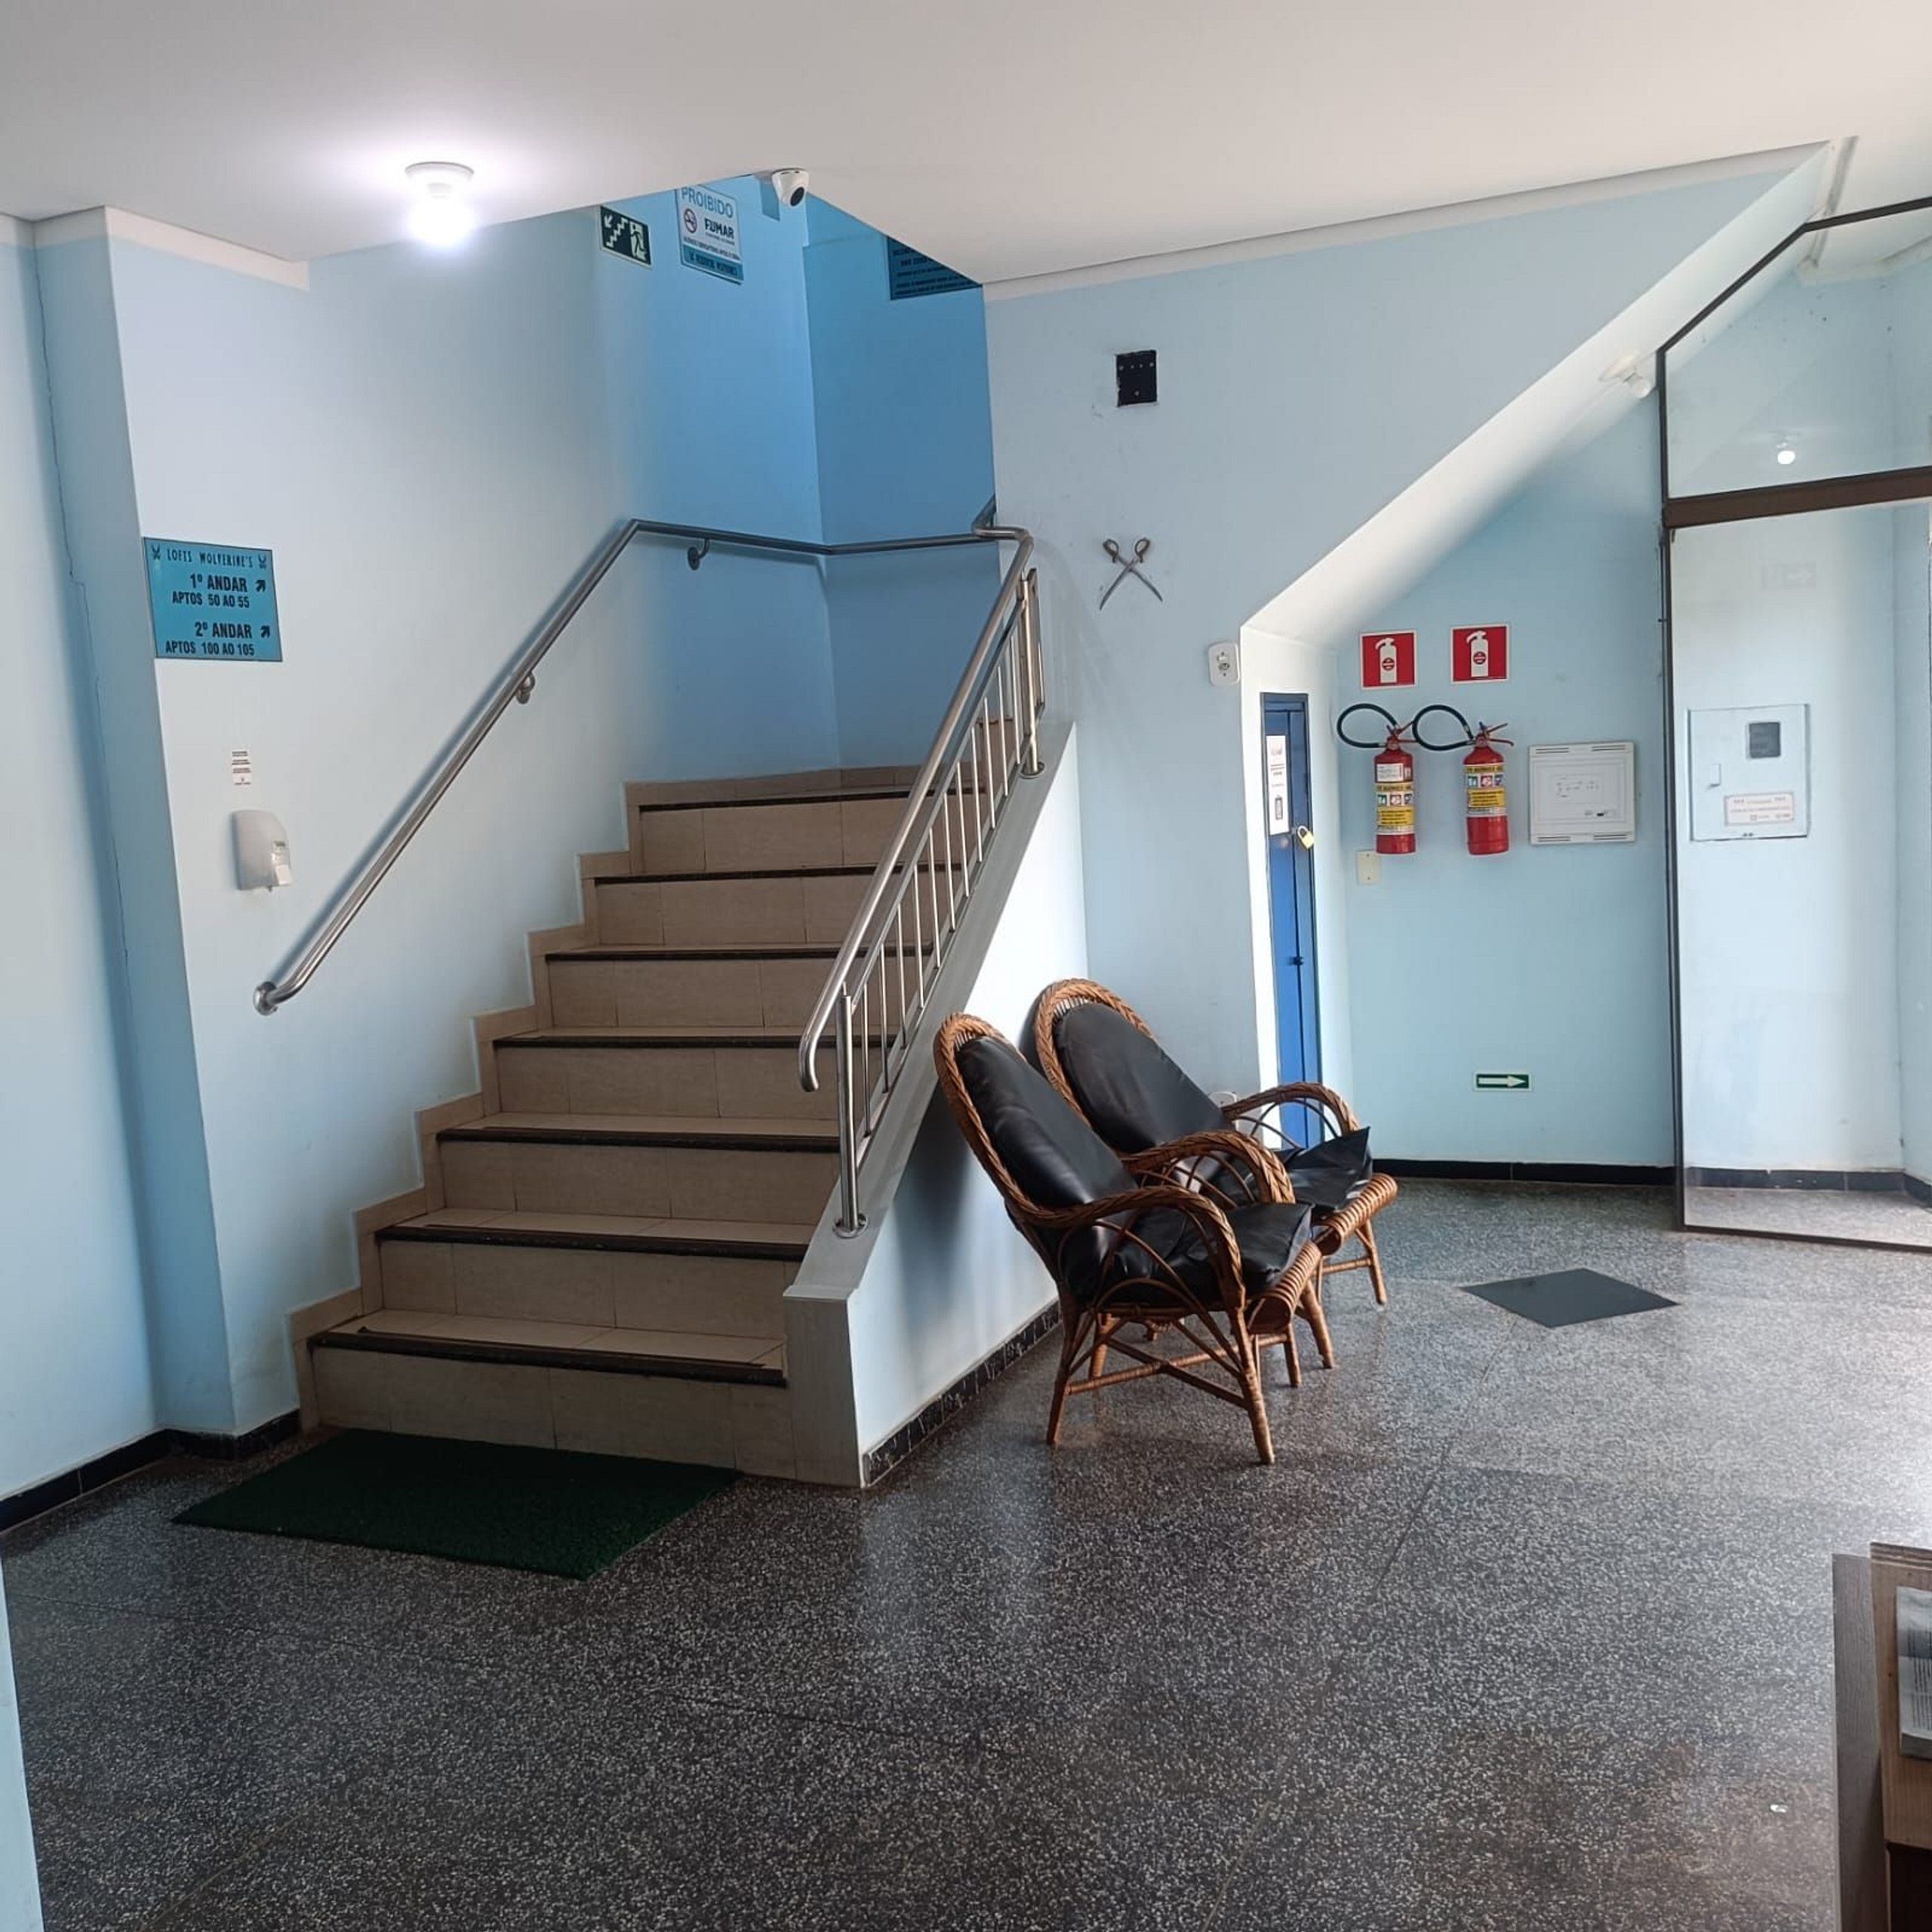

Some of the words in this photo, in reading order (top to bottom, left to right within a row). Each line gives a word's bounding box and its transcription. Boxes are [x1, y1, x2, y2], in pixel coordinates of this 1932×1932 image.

[681, 187, 734, 218] PROIBIDO
[704, 218, 735, 239] FUMAR
[167, 549, 192, 562] LOFTS
[199, 552, 253, 568] WOLVERINE'S
[208, 575, 248, 592] ANDAR
[172, 591, 202, 605] APTOS
[208, 593, 220, 607] 50
[223, 595, 235, 608] AO
[238, 596, 250, 608] 55
[212, 623, 252, 638] ANDAR
[165, 640, 195, 654] APTOS
[202, 642, 219, 655] 100
[223, 643, 235, 655] AO
[238, 644, 255, 656] 105
